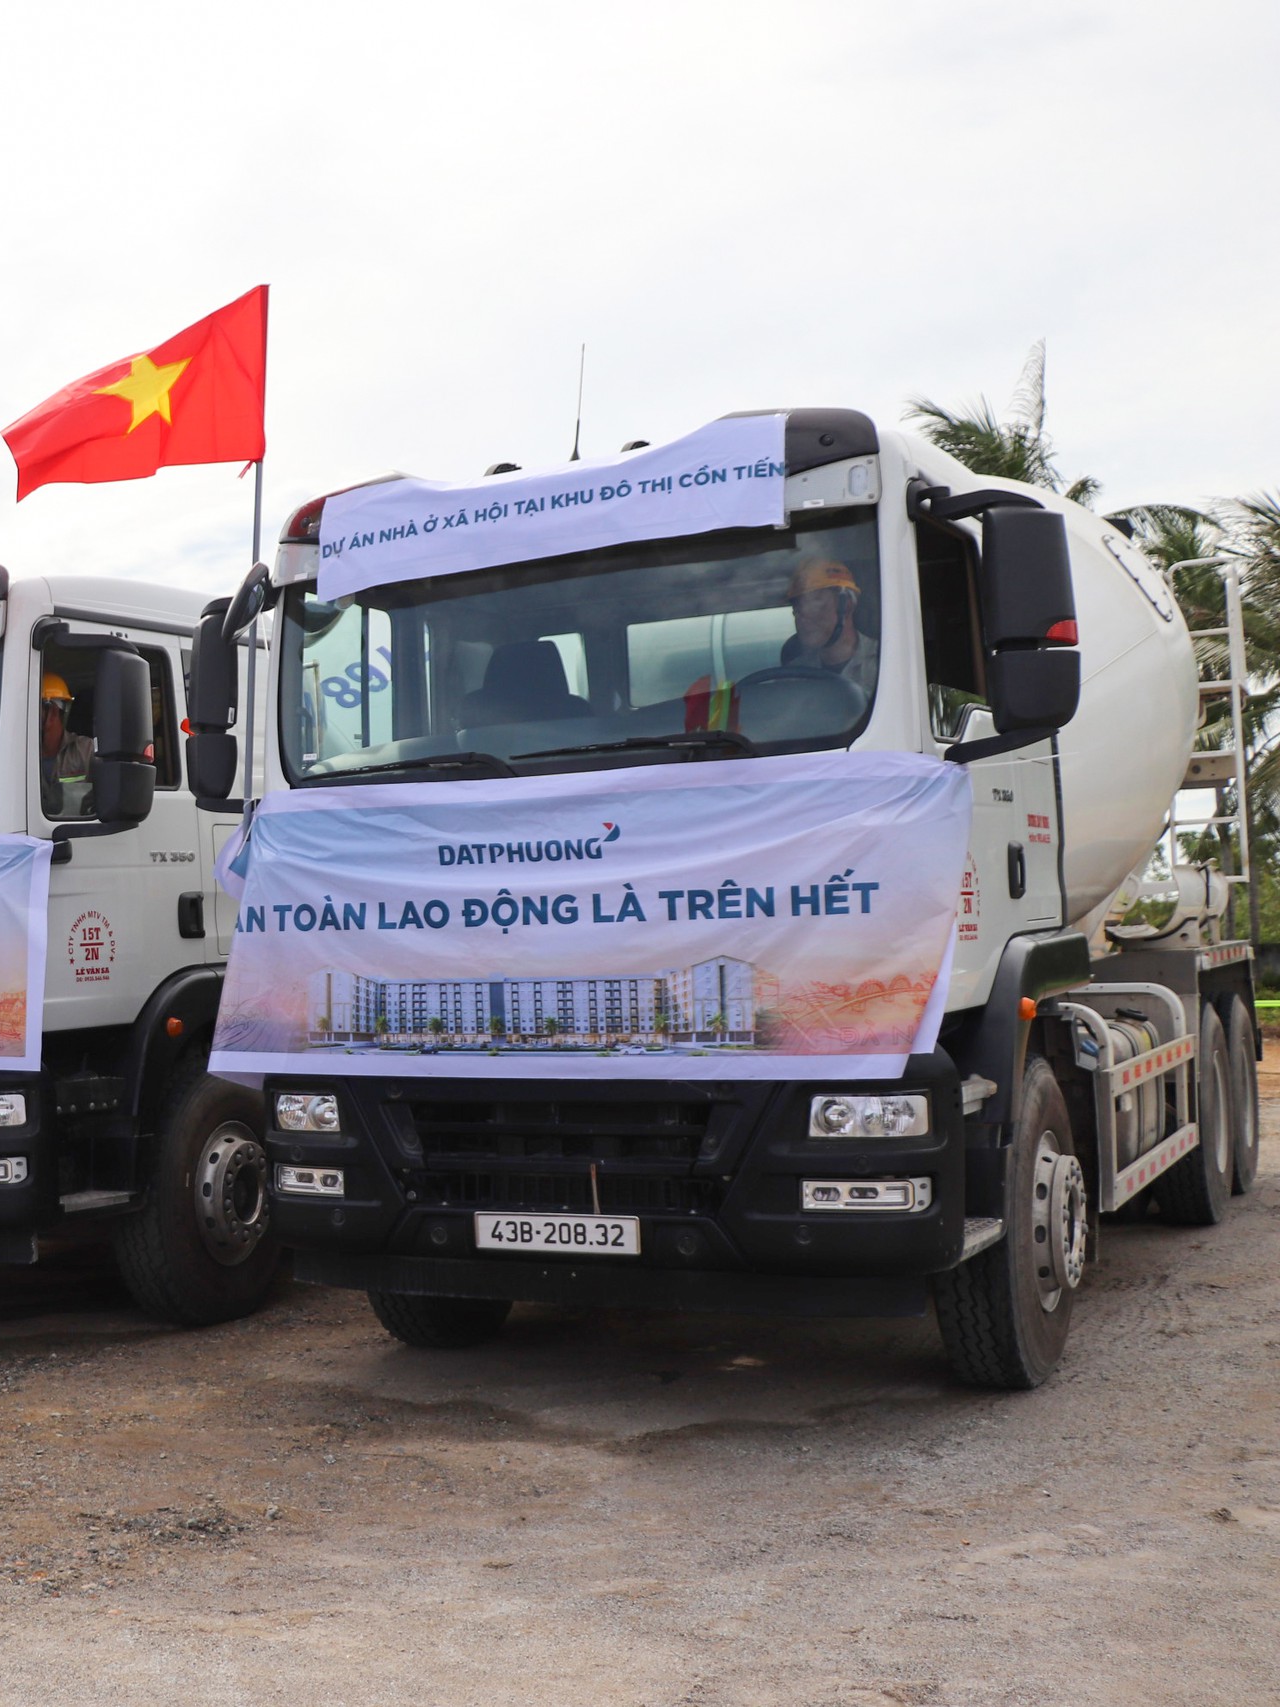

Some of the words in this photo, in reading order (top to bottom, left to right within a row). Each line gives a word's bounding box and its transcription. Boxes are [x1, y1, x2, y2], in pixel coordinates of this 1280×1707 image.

[322, 537, 346, 558] DỰ
[349, 531, 374, 550] ÁN
[379, 519, 419, 543] NHÀ
[423, 513, 438, 533] Ở
[442, 508, 469, 529] XÃ
[474, 502, 508, 523] HỘI
[514, 497, 545, 517] TẠI
[551, 489, 594, 509] KHU
[600, 480, 632, 501] ĐÔ
[638, 475, 673, 494] THỊ
[678, 465, 727, 488] CỒN
[733, 456, 785, 480] TIẾN
[438, 837, 603, 866] DATPHUONG
[273, 894, 367, 932] TOÀN
[377, 899, 451, 930] LAO
[461, 888, 579, 934] ĐỘNG
[592, 882, 647, 924] LÀ
[658, 879, 776, 921] TRÊN
[790, 868, 880, 917] HẾT
[82, 927, 102, 941] 15T
[85, 947, 100, 961] 2N
[491, 1220, 625, 1247] 43B-208.32
